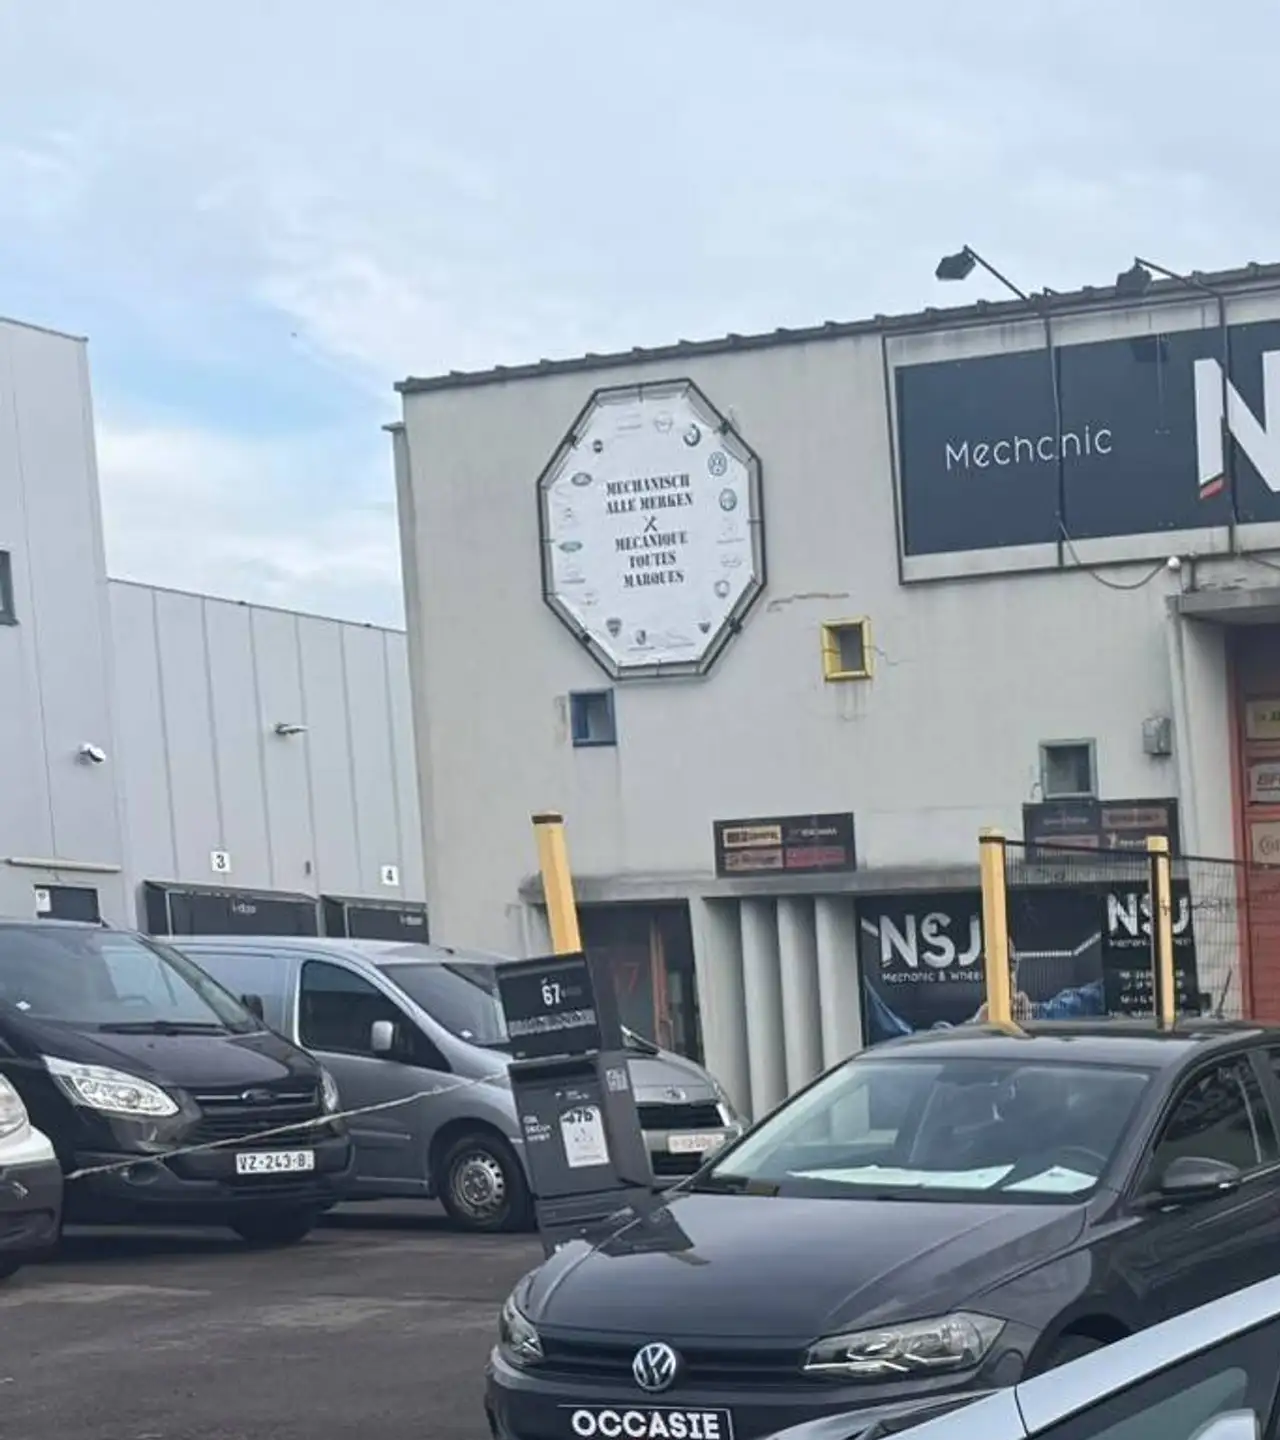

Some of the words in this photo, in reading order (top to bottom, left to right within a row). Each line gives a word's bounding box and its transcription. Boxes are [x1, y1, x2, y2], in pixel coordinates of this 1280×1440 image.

[605, 473, 691, 496] MECHANISCH
[605, 499, 637, 515] ALLE
[639, 493, 694, 512] MERKEN
[614, 531, 689, 552] MECANIQUE
[628, 551, 677, 569] TOUTES
[623, 570, 685, 588] MARQUES
[215, 854, 226, 869] 3
[385, 869, 394, 882] 4
[879, 912, 981, 968] NSJ
[541, 983, 561, 1006] 67
[571, 1410, 721, 1440] OCCASIE
